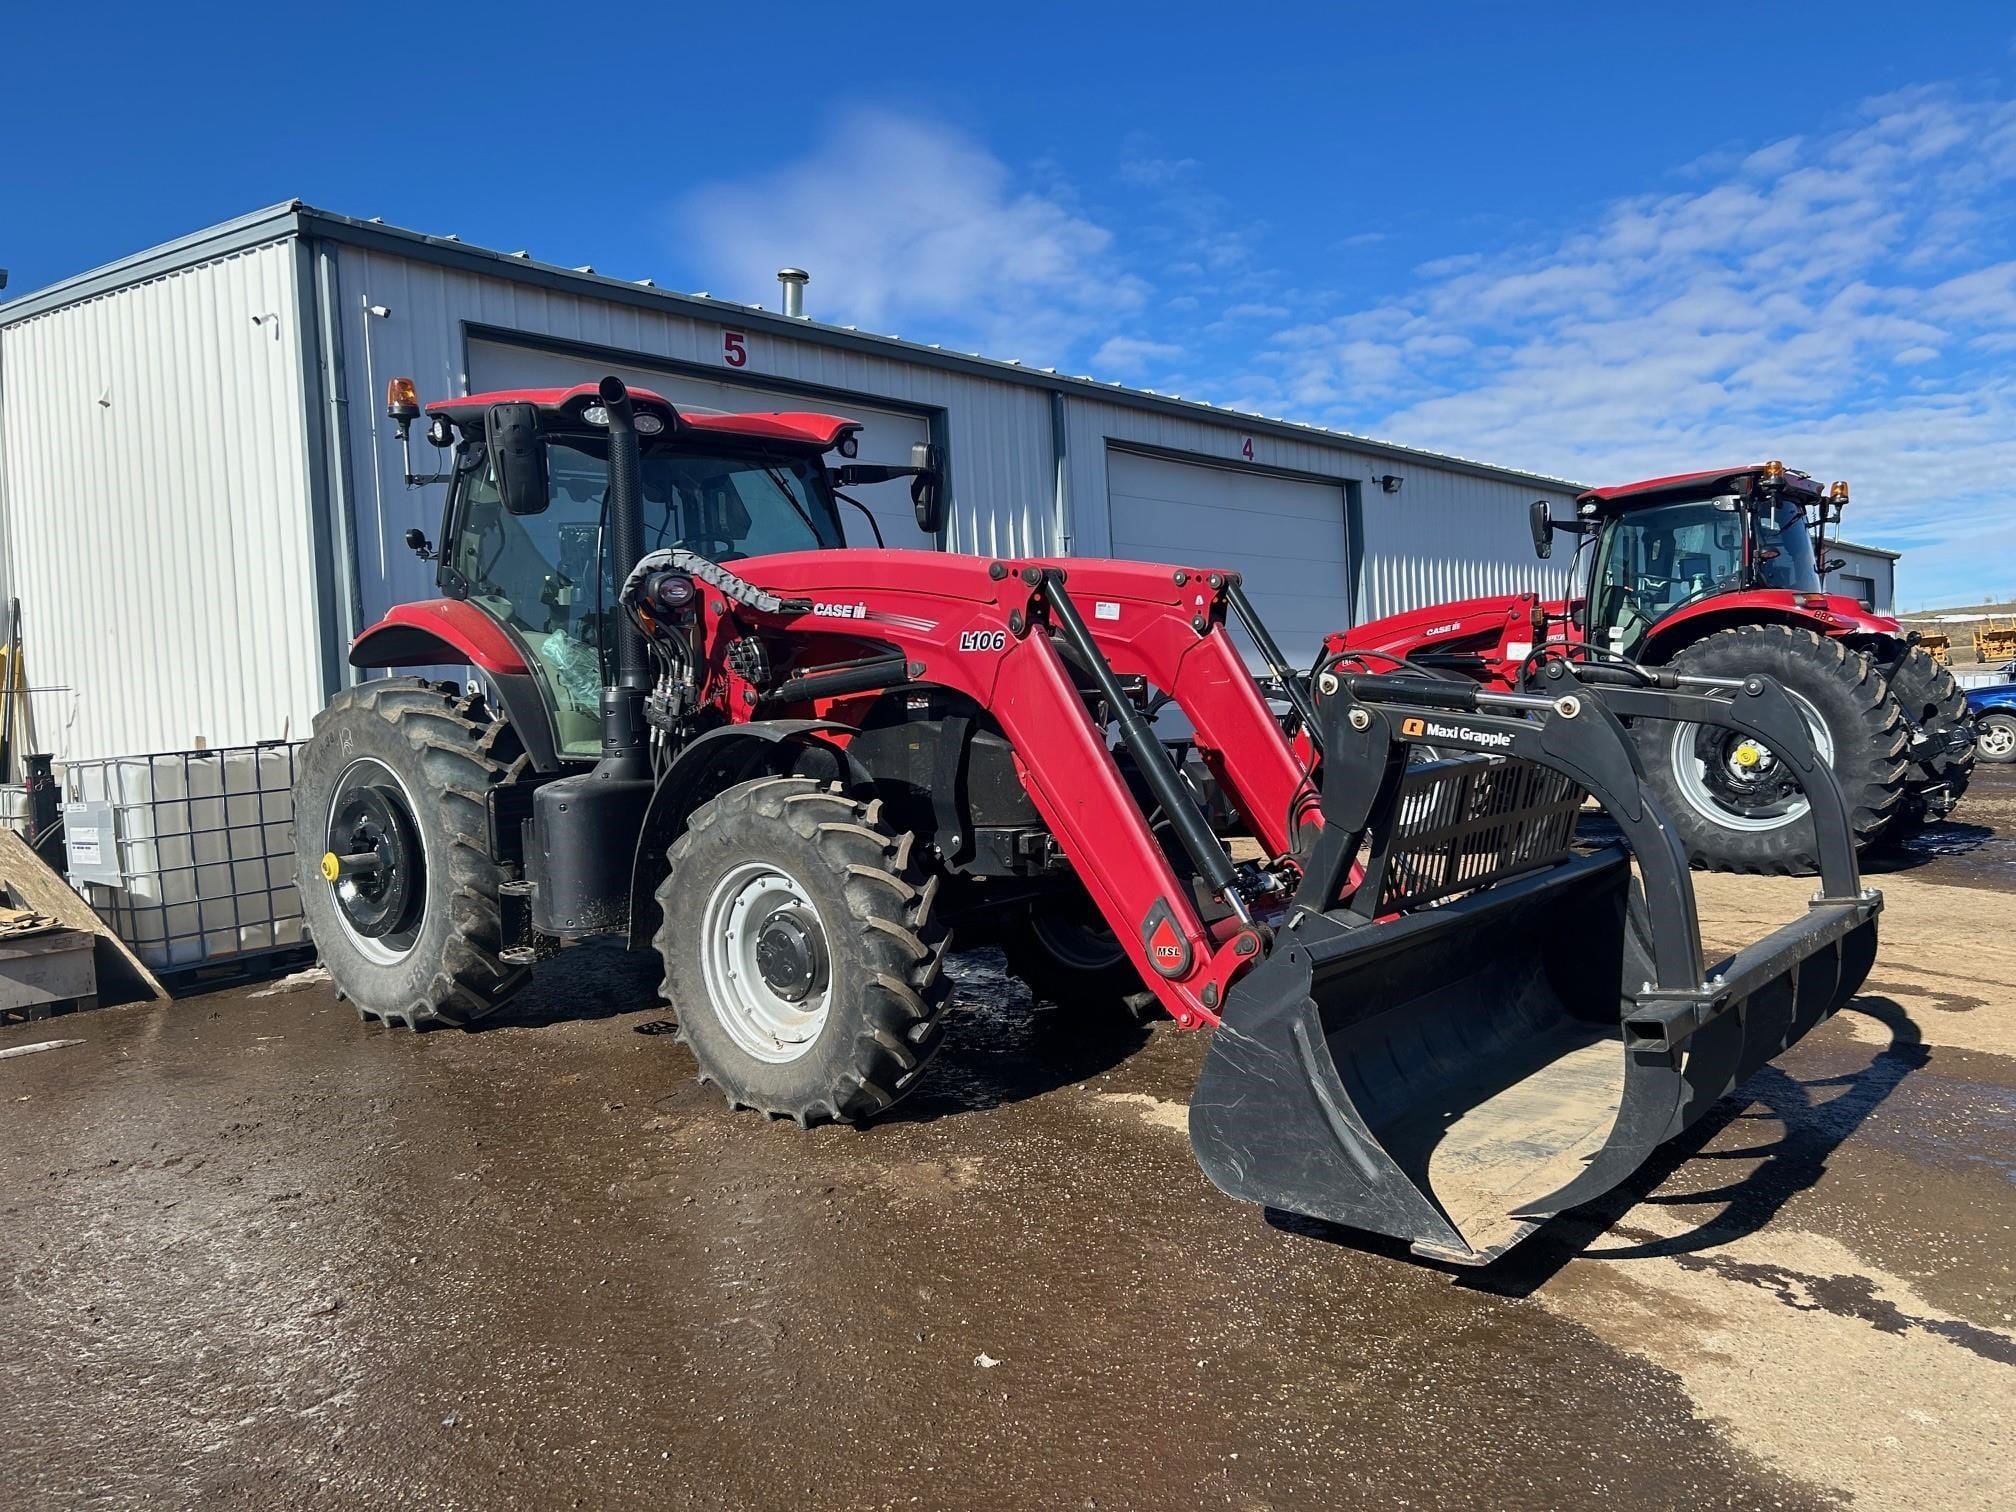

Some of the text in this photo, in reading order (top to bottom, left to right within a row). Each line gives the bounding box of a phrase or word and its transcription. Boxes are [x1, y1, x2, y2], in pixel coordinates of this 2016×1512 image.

[725, 333, 746, 367] 5
[1243, 438, 1254, 461] 4
[813, 602, 853, 618] CASE
[959, 630, 1006, 651] L106
[1426, 624, 1452, 636] CASE
[1426, 723, 1511, 747] Maxi Grapple
[1156, 946, 1180, 956] MSL
